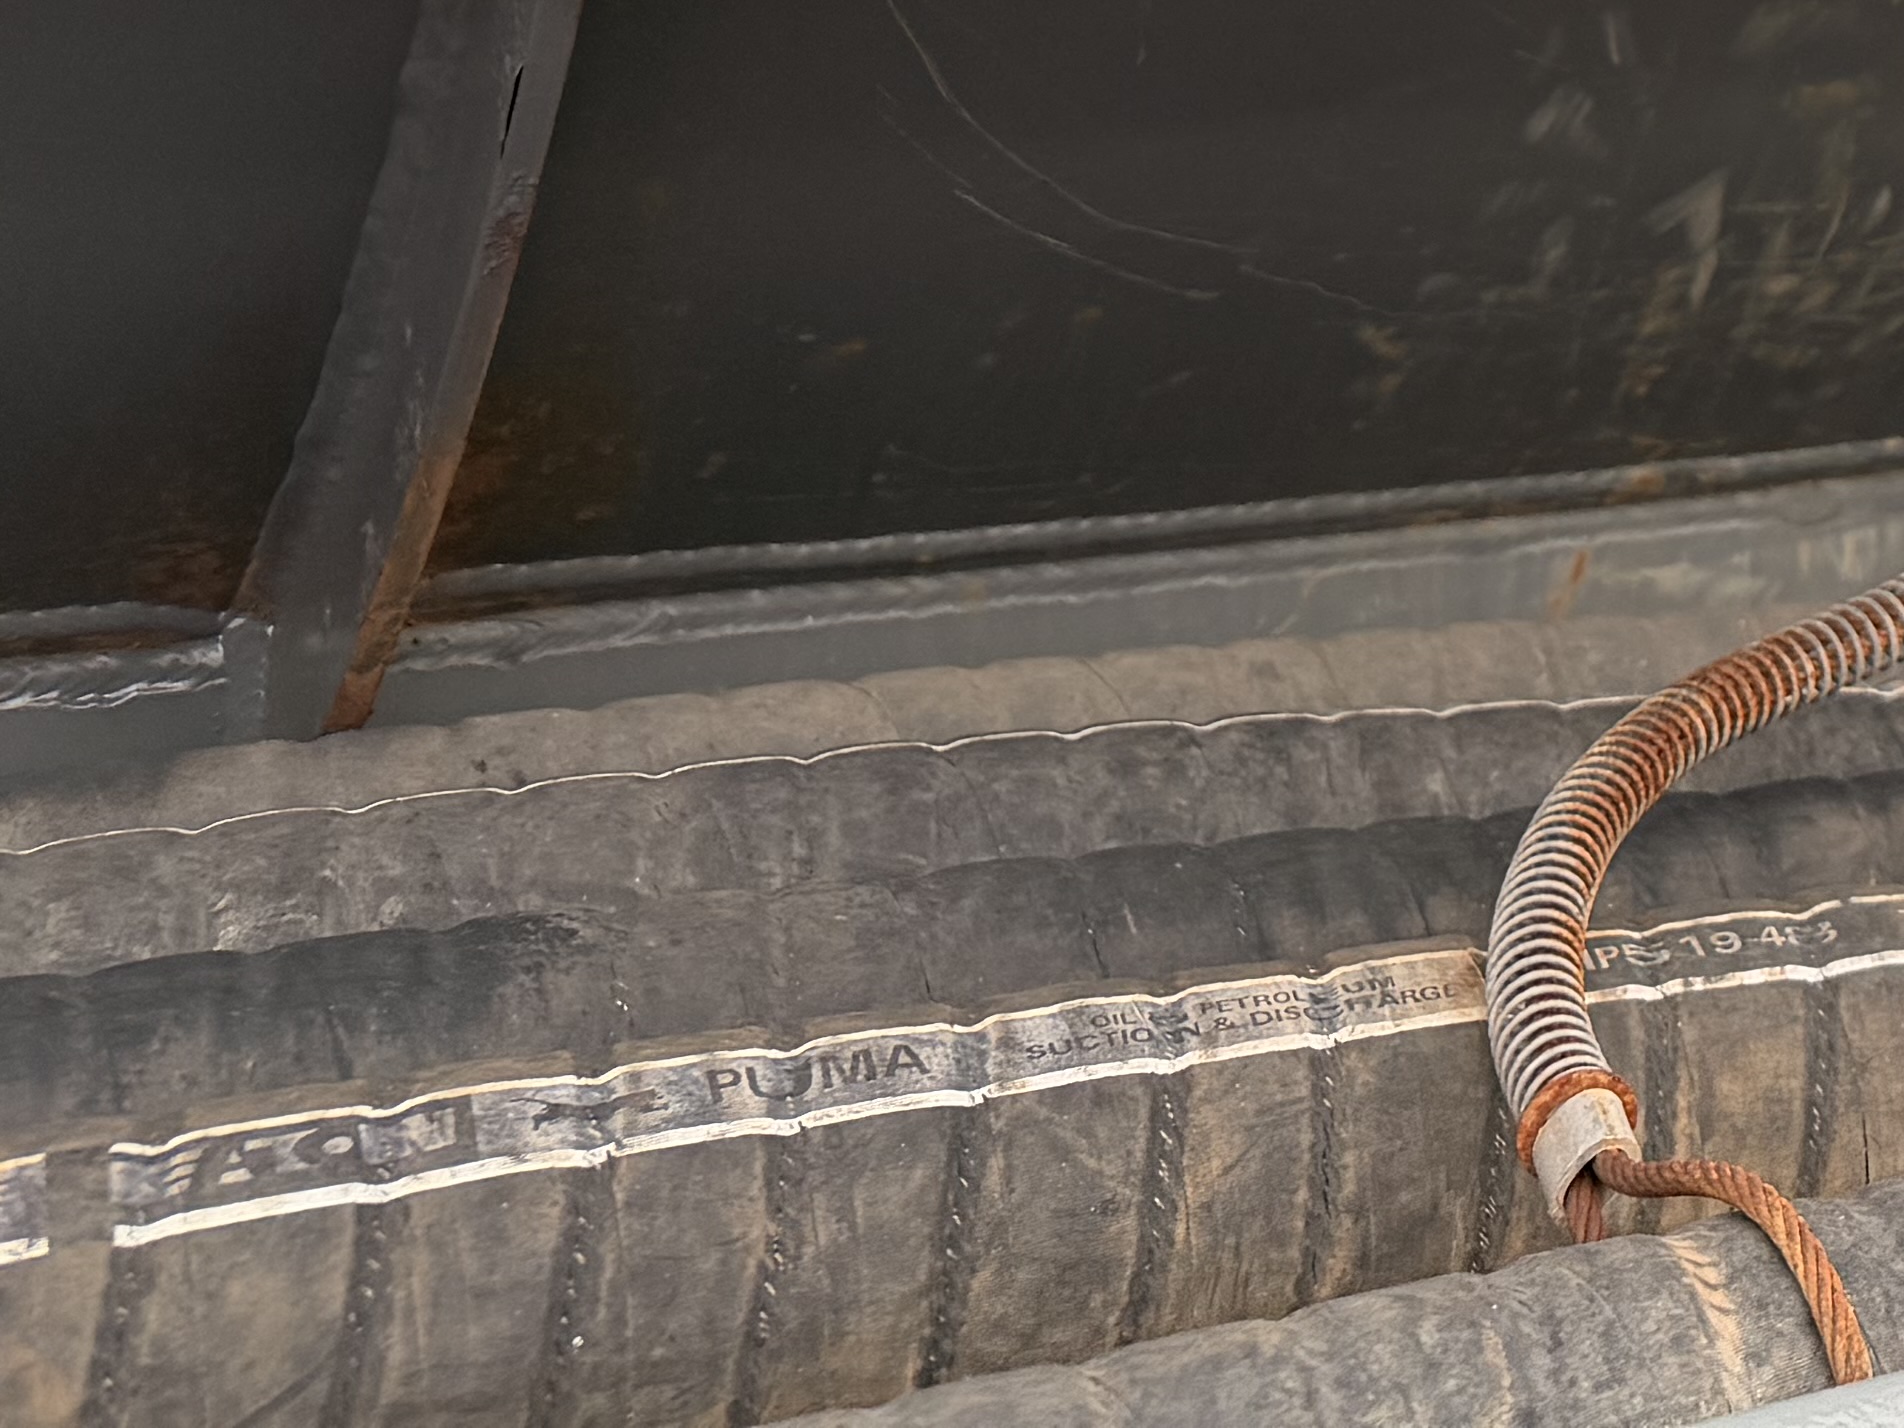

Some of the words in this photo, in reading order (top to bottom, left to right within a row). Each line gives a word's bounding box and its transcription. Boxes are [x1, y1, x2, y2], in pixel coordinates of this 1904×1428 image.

[1088, 1008, 1139, 1030] OIL
[1200, 974, 1398, 1017] PETROLEUM
[1024, 1021, 1202, 1062] SUCTION
[1212, 1016, 1236, 1032] &
[704, 1044, 930, 1104] PUMA
